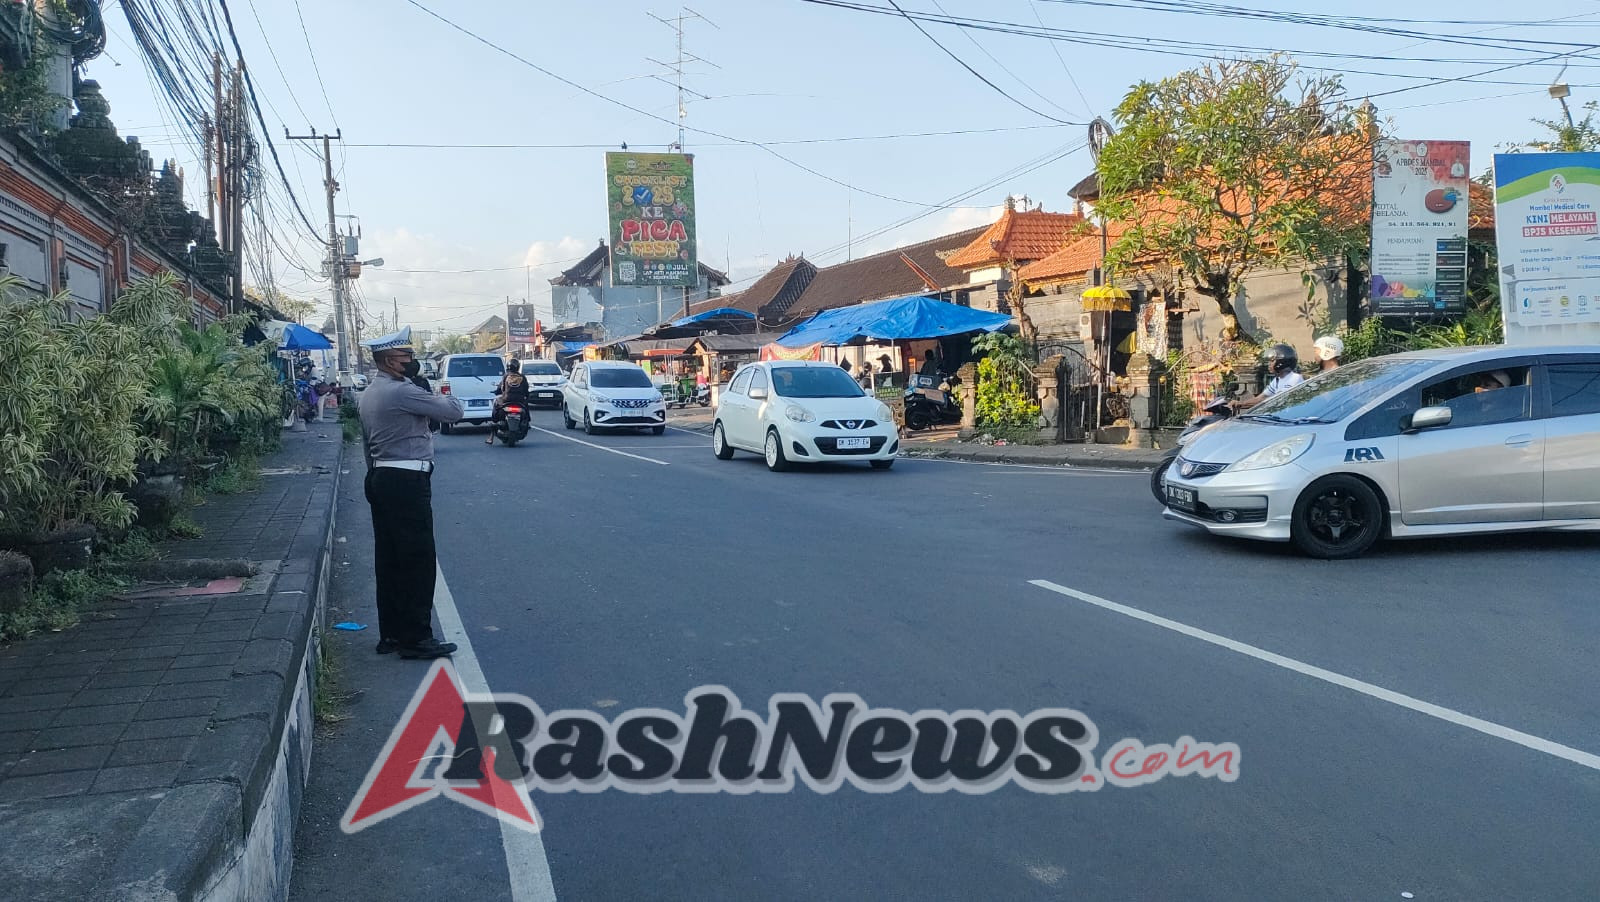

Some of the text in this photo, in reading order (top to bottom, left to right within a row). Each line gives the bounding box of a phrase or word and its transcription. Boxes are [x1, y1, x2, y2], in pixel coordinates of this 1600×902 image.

[614, 175, 688, 188] CHECKLIST
[641, 206, 664, 218] KE
[1526, 212, 1594, 224] KINI MELAYANI
[620, 219, 689, 243] PICA
[1524, 225, 1598, 237] BPJS KESEHATAN
[629, 240, 681, 258] FEST
